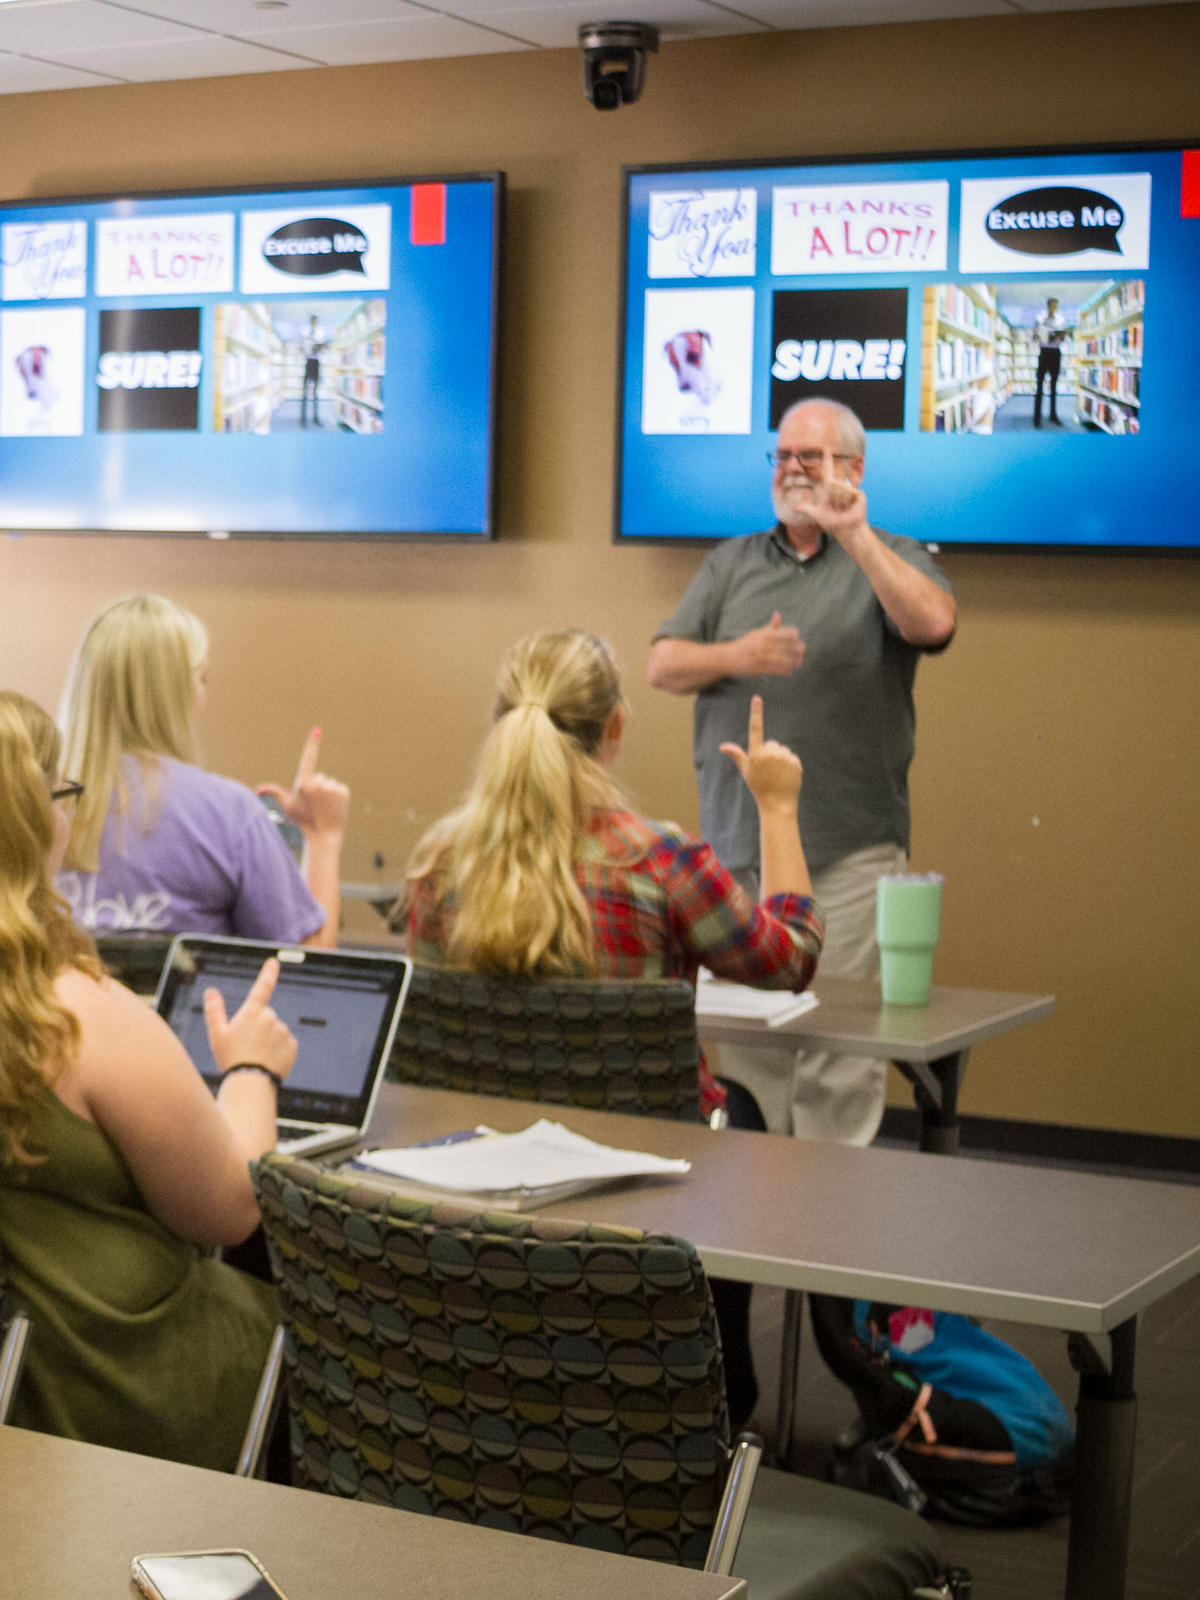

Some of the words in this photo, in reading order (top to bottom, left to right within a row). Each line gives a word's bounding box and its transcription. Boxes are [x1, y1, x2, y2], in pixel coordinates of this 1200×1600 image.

[647, 188, 747, 240] Thank
[785, 200, 934, 220] THANKS
[988, 209, 1076, 230] Excuse
[1081, 206, 1122, 228] Me
[0, 222, 78, 267] Thank
[107, 231, 223, 246] THANKS
[263, 236, 332, 256] Excuse
[333, 232, 368, 253] Me
[677, 226, 756, 278] You
[810, 226, 834, 260] A
[843, 220, 936, 260] LOT!!
[127, 254, 145, 281] A
[152, 248, 225, 282] LOT!!
[96, 350, 202, 389] SURE!
[772, 339, 906, 381] SURE!
